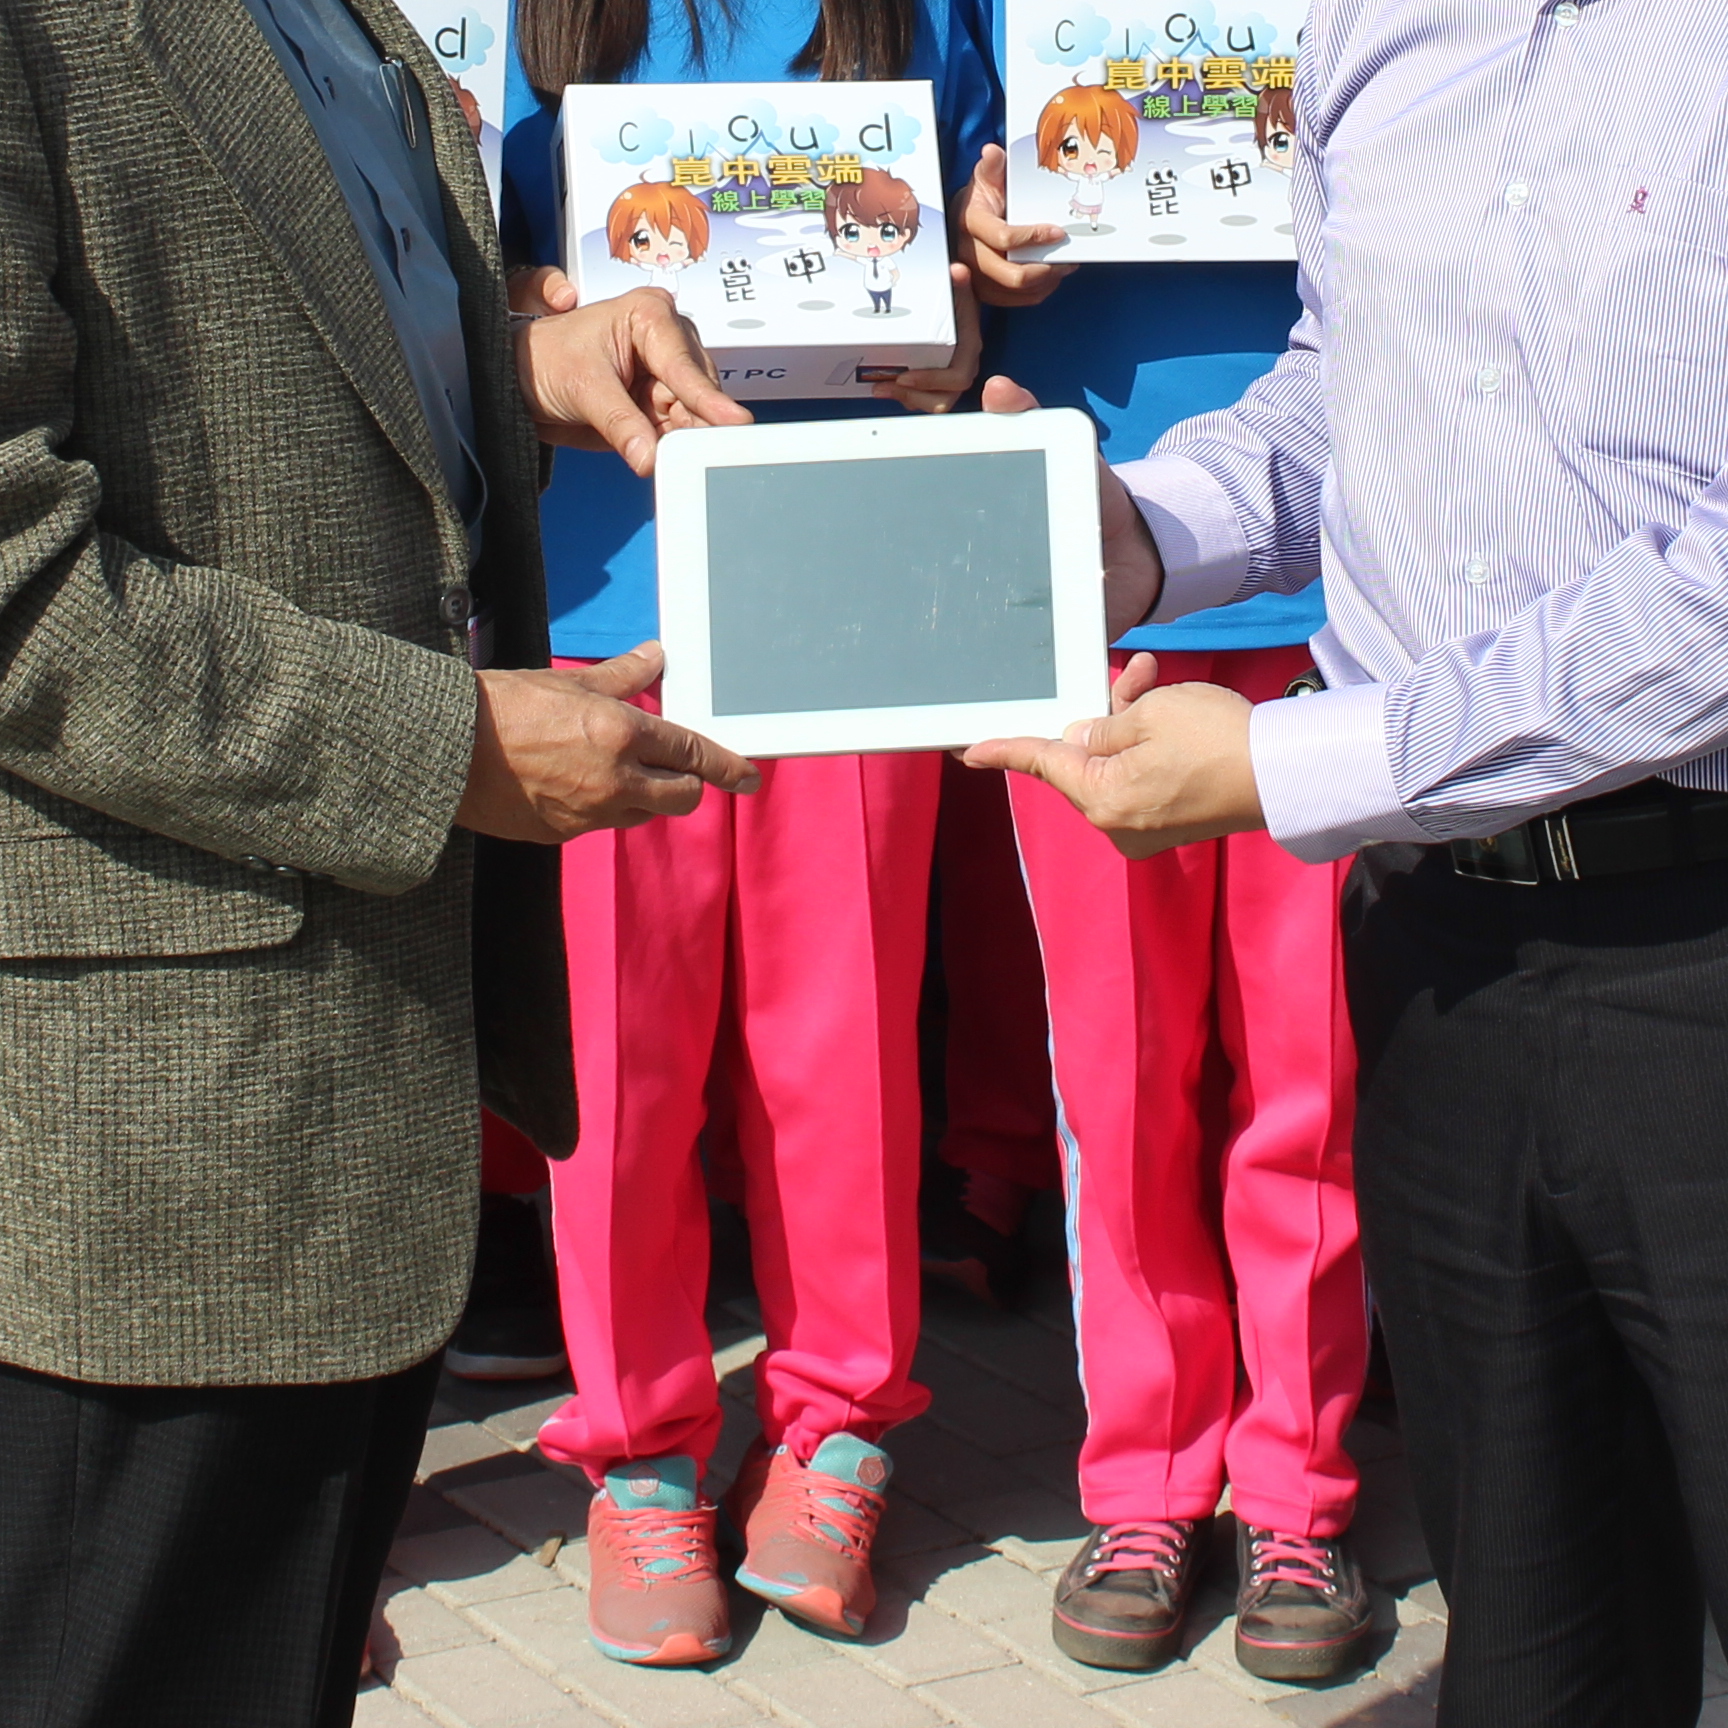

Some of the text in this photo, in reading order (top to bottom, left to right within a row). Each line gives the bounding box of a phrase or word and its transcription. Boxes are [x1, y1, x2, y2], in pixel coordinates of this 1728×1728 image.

[1055, 13, 1303, 56] Clou
[1143, 95, 1258, 119] 線上學習
[712, 190, 827, 212] 線上學習
[745, 368, 787, 379] PC
